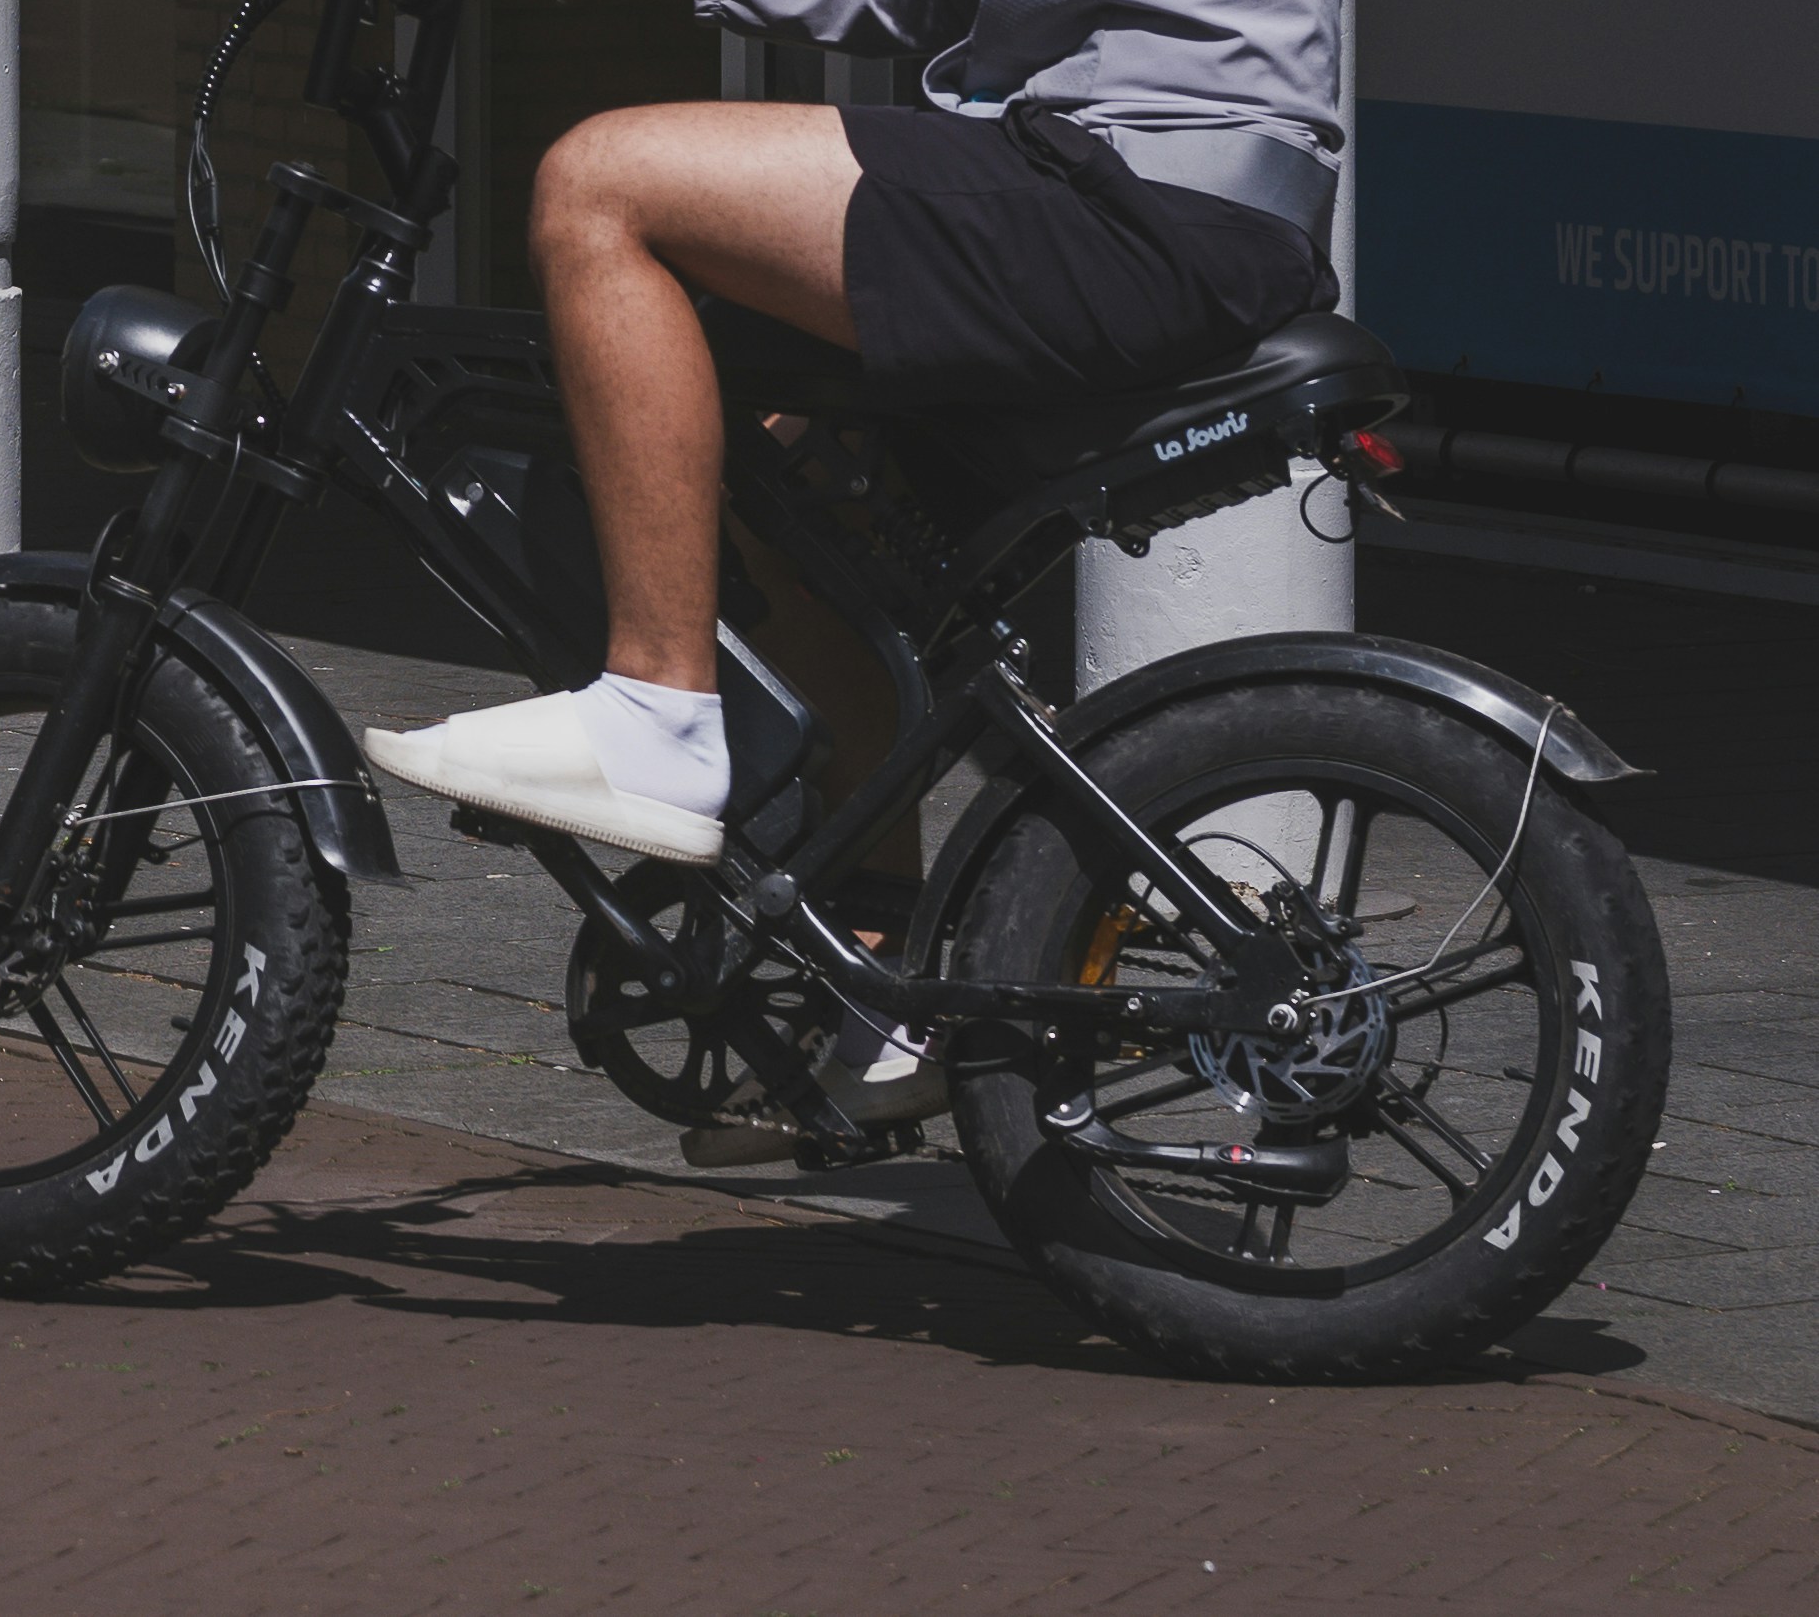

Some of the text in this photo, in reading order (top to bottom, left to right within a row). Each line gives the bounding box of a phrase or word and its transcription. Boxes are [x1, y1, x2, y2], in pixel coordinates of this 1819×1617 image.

[1556, 222, 1603, 289] WE
[1613, 228, 1773, 306] SUPPORT
[87, 941, 269, 1197] KENDA
[1482, 958, 1604, 1252] KENDA
